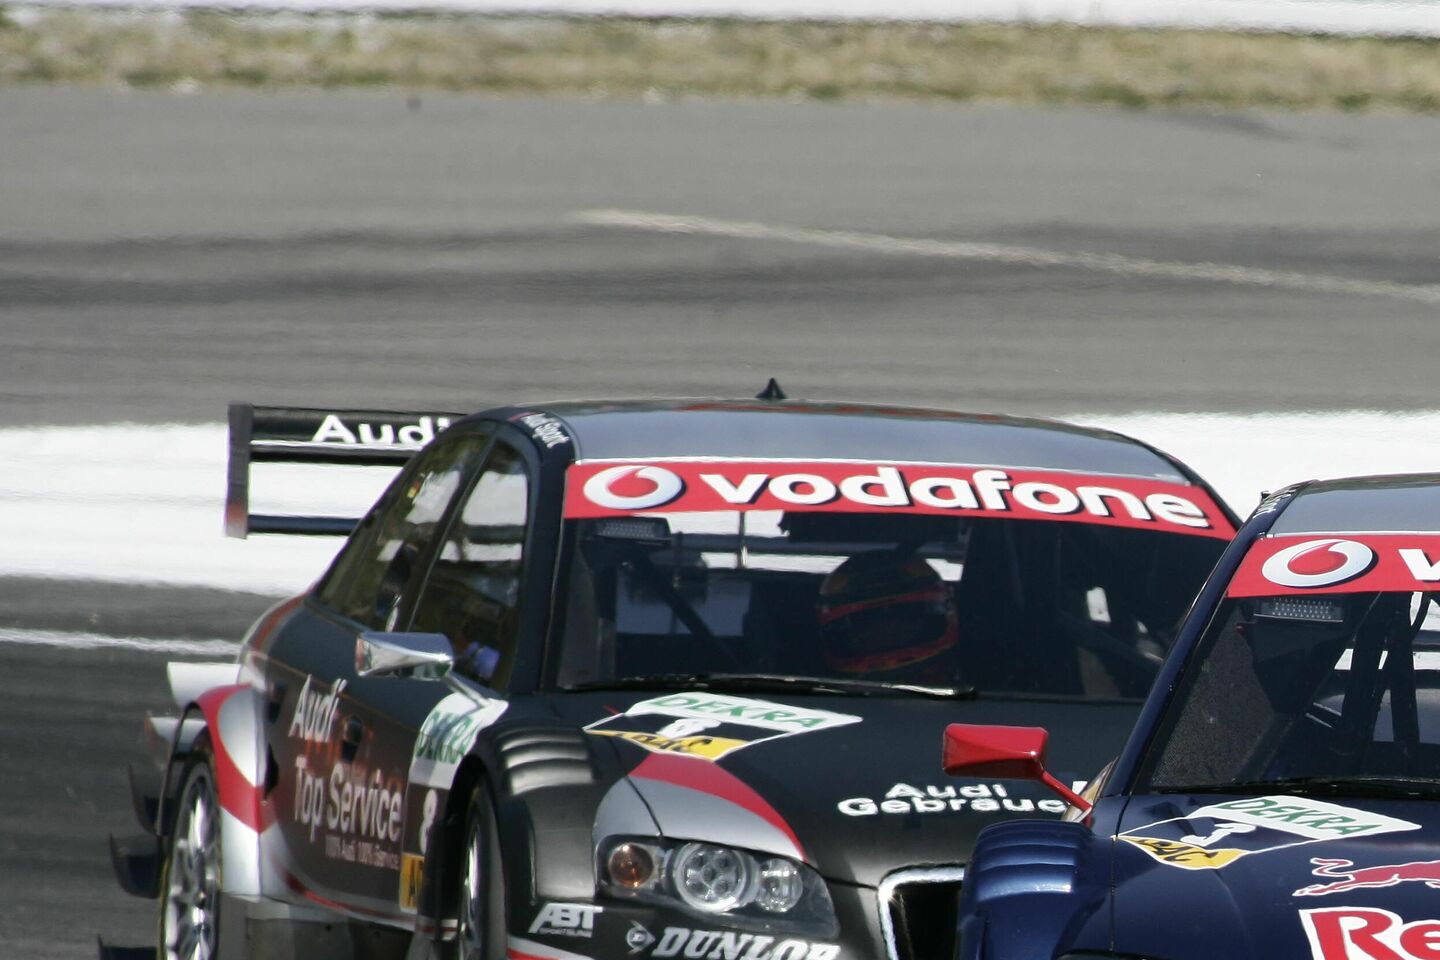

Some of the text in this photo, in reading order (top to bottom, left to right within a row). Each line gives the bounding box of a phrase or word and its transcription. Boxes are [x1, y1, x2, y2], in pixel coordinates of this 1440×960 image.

[311, 414, 451, 445] Aud
[701, 466, 1210, 528] vodafone
[288, 674, 347, 743] Audi
[652, 696, 827, 729] DEKRA
[295, 756, 402, 843] Top Service
[837, 797, 1072, 817] Gebrauc
[885, 782, 1008, 800] Audi
[1215, 798, 1382, 836] DEKRA
[528, 902, 604, 935] ABT
